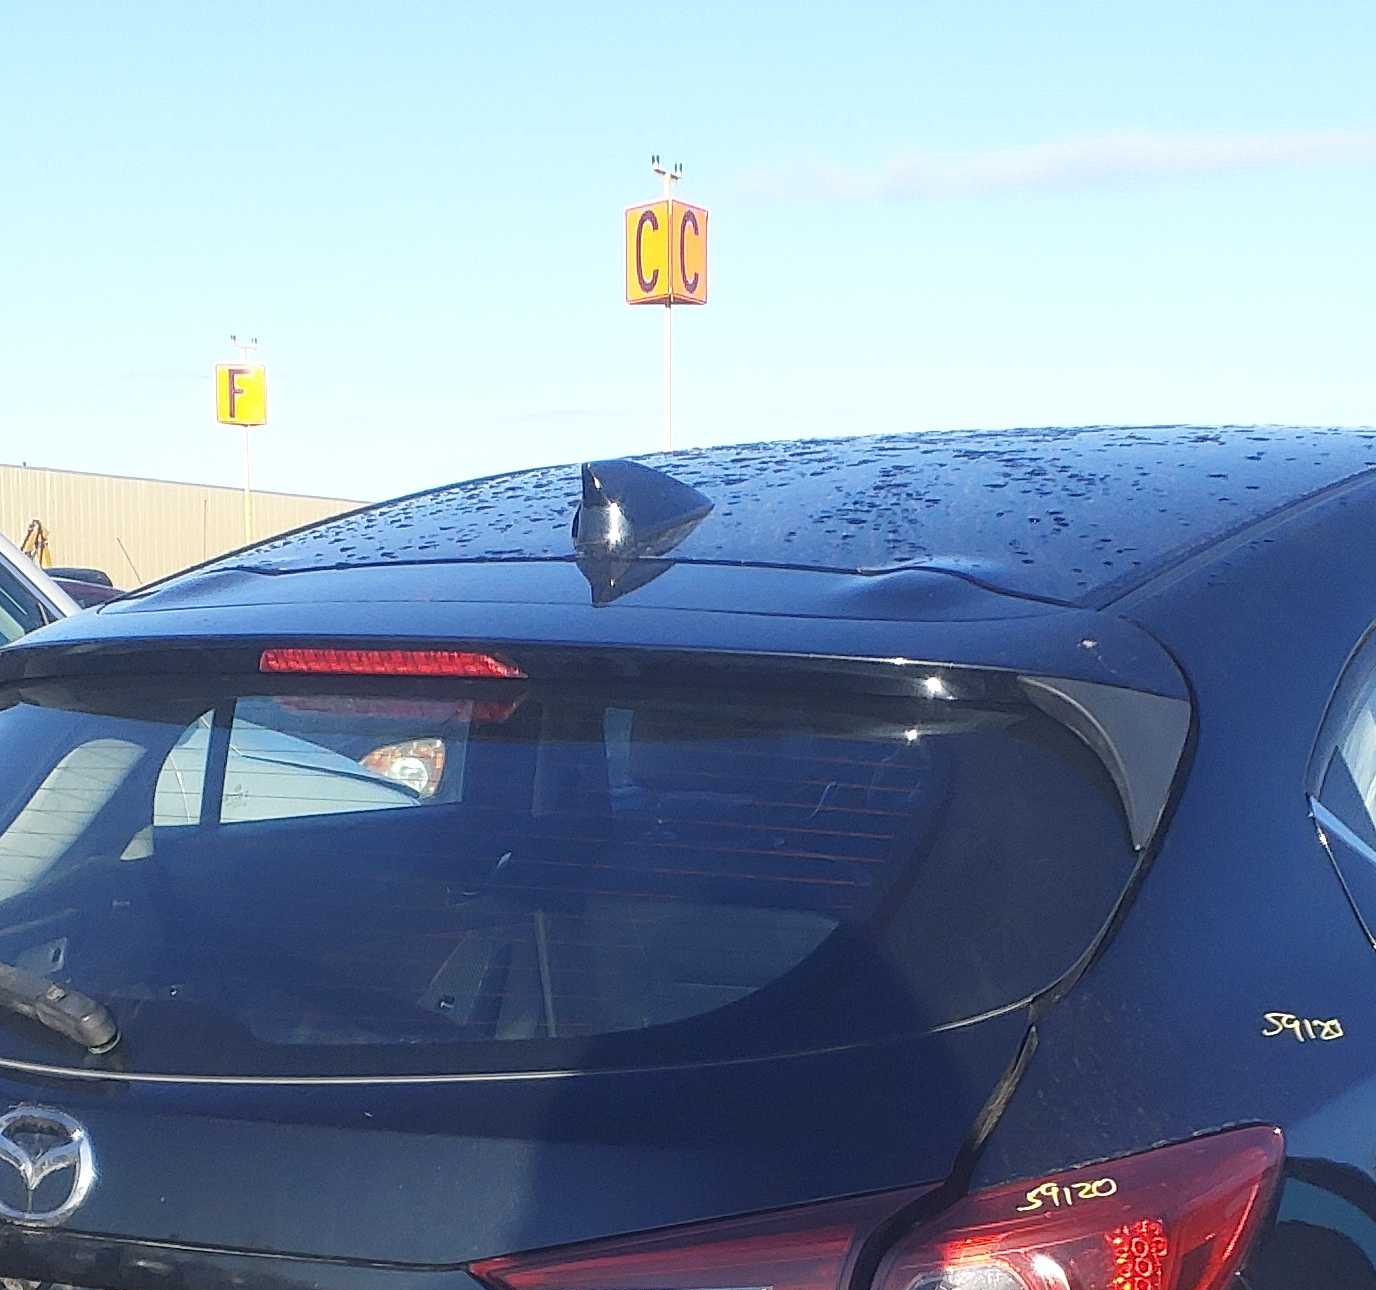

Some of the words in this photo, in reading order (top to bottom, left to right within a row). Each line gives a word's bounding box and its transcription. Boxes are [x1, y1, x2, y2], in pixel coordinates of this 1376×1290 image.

[636, 210, 659, 293] C
[680, 210, 699, 293] C
[228, 368, 250, 418] F
[1016, 1178, 1118, 1212] 59120
